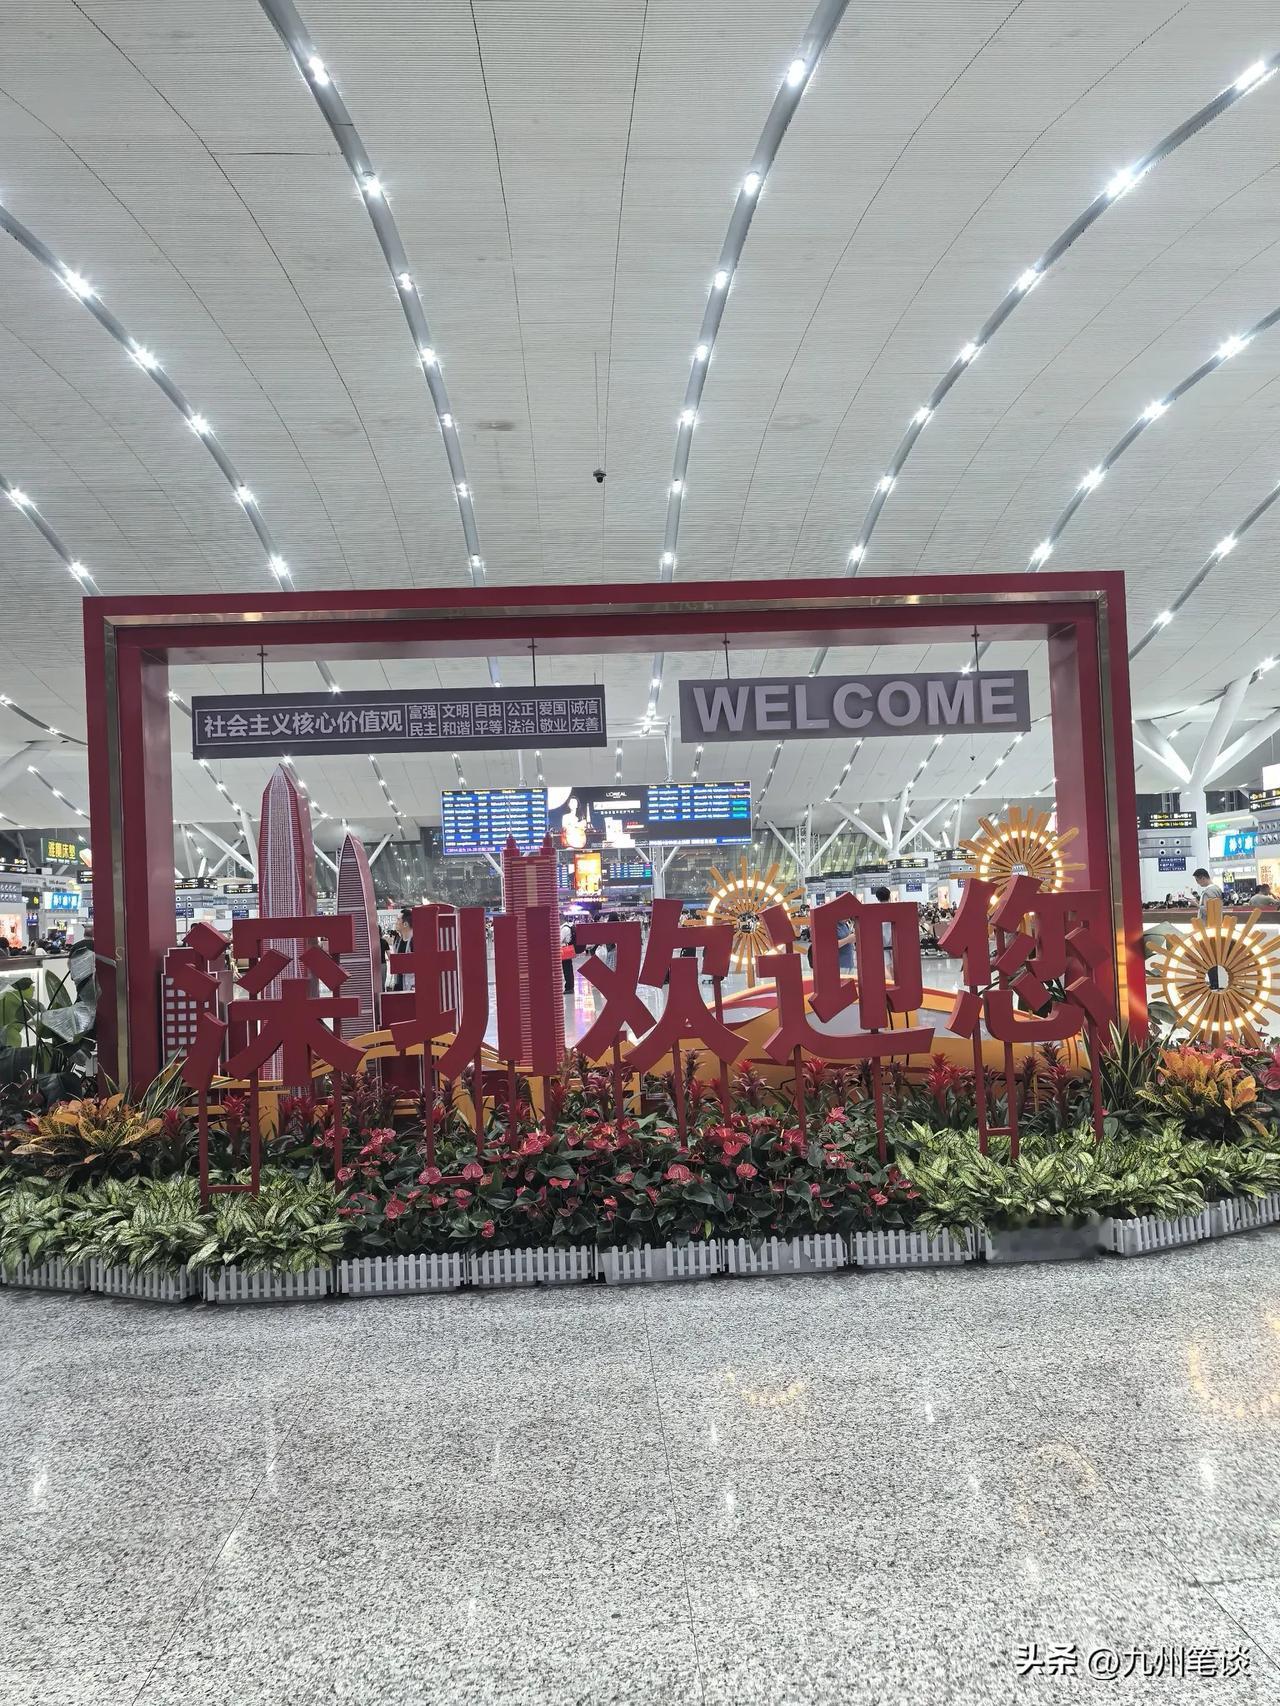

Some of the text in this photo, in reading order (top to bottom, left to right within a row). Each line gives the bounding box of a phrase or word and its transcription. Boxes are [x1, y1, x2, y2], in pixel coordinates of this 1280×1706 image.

[409, 700, 598, 719] 富强 文明 自由 公正 爱国 诚信
[693, 678, 1018, 733] WELCOME
[204, 709, 403, 739] 社会主义核心价值观
[410, 717, 599, 736] 民主 和谐 平等 法治 敬业 友善
[182, 875, 1115, 1089] 深圳欢迎您
